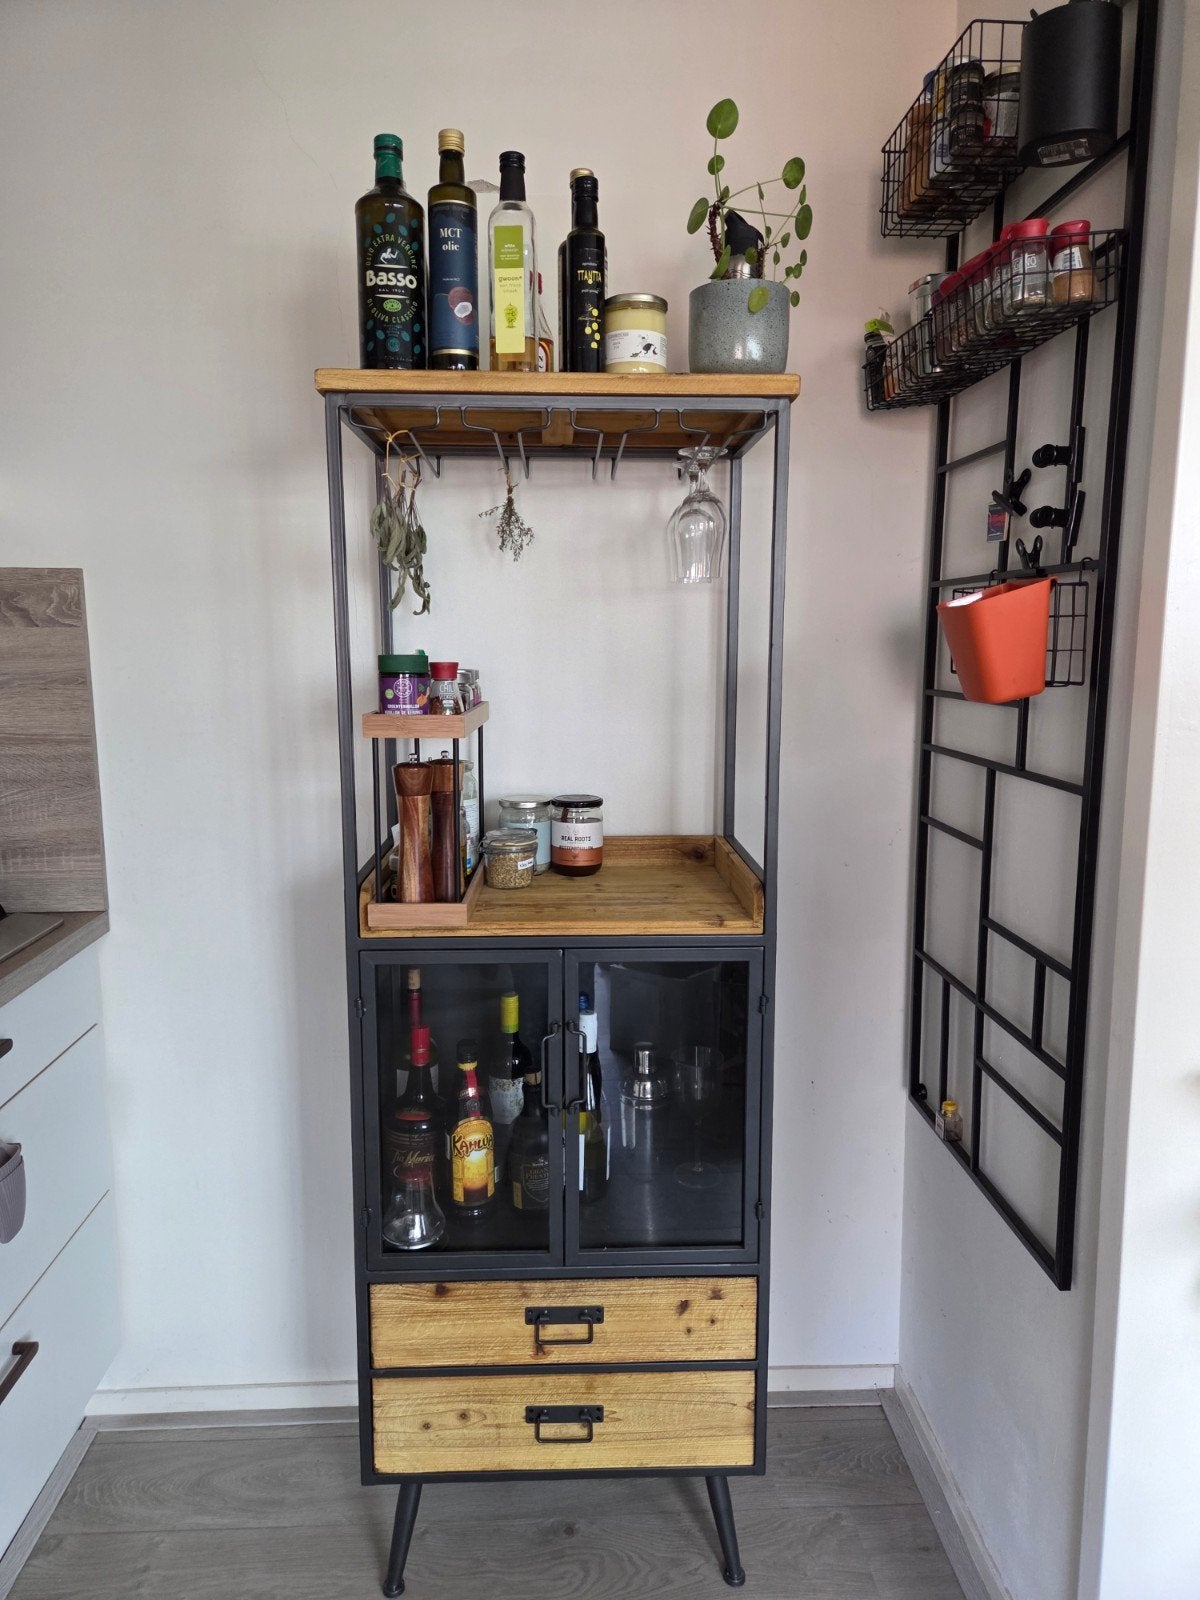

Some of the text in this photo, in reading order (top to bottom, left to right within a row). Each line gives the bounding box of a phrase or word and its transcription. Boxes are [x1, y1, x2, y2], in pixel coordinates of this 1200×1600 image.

[440, 227, 463, 238] MCT
[372, 233, 395, 247] EXTRA
[398, 236, 418, 270] VERGINE
[442, 241, 460, 251] olie
[365, 269, 418, 289] Basso
[371, 307, 389, 323] OLIVA
[391, 301, 418, 324] CLASSICO
